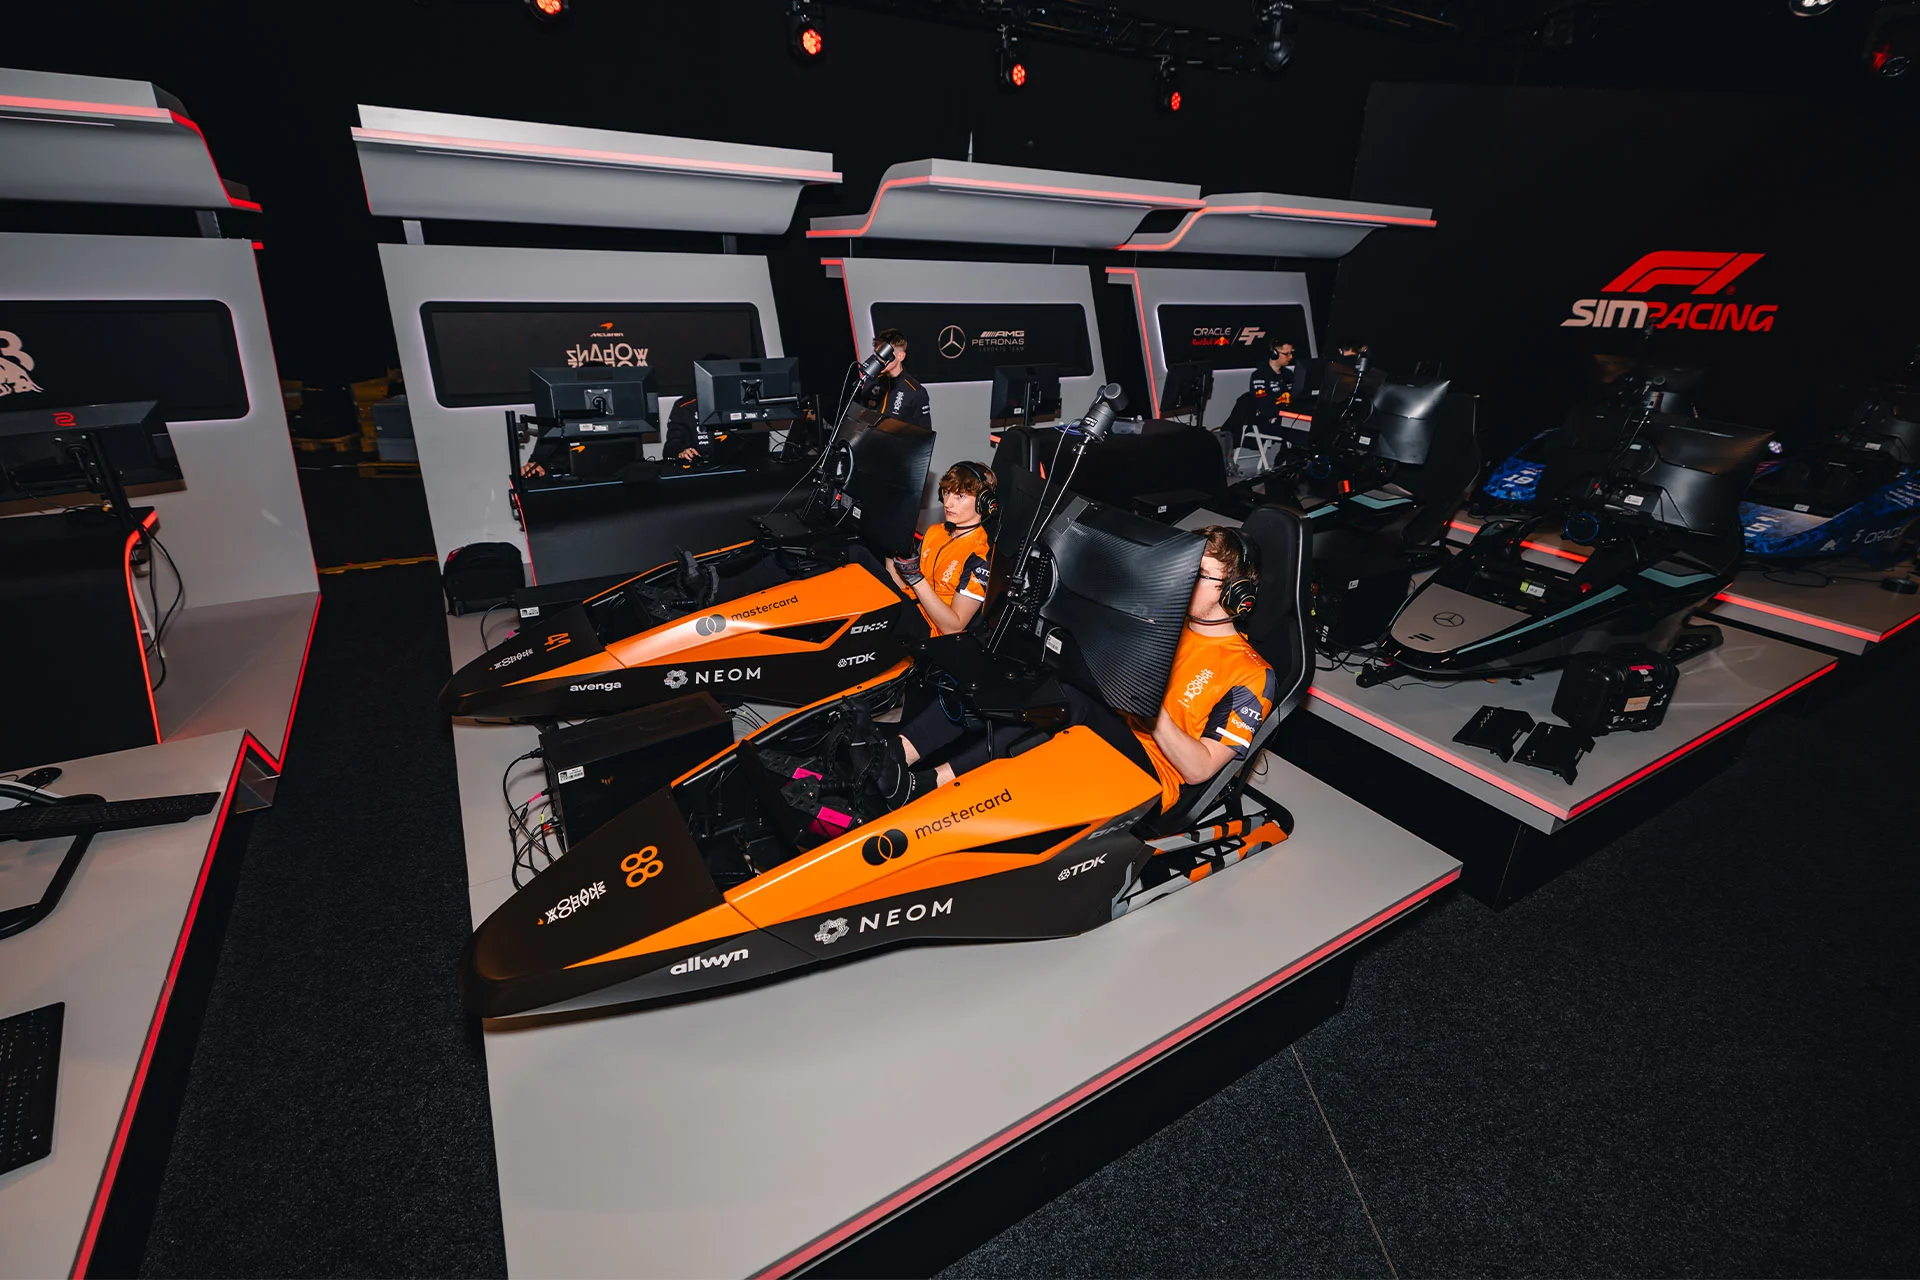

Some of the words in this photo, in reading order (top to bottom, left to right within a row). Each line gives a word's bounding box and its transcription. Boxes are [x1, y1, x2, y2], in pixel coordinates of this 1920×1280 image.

[1600, 249, 1767, 295] F1
[971, 338, 1025, 347] PETRONAS
[1193, 327, 1231, 336] ORACLE
[731, 594, 799, 622] mastercard
[846, 651, 877, 666] TDK
[569, 681, 622, 692] avenga
[695, 667, 762, 685] NEOM
[914, 788, 1013, 840] mastercard
[620, 844, 664, 889] 88
[1069, 852, 1109, 877] TDK
[858, 897, 954, 934] NEOM
[669, 948, 749, 976] allwyn
